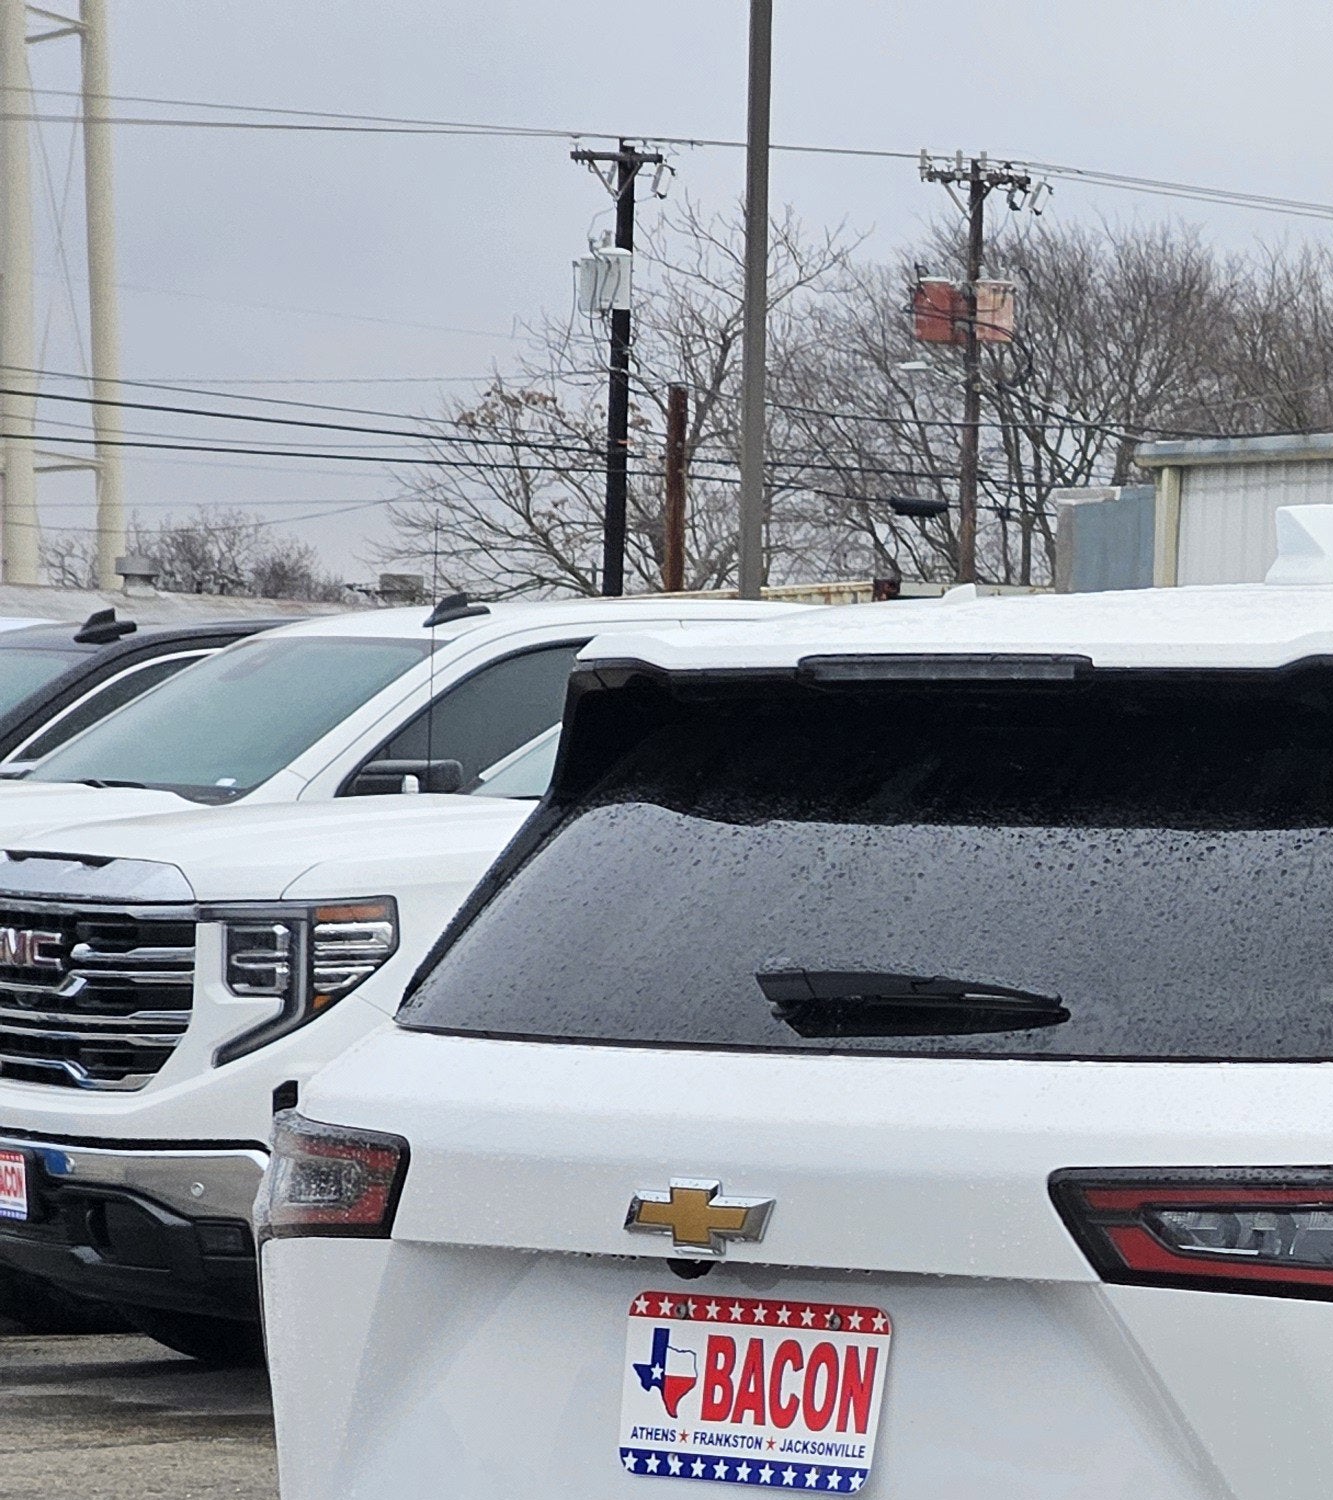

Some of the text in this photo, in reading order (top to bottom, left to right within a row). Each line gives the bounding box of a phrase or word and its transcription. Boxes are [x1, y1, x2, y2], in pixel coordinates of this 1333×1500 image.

[0, 927, 63, 970] MC
[700, 1334, 879, 1434] BACON
[630, 1426, 866, 1459] ATHENS FRANKSTON JACKSONVILLE
